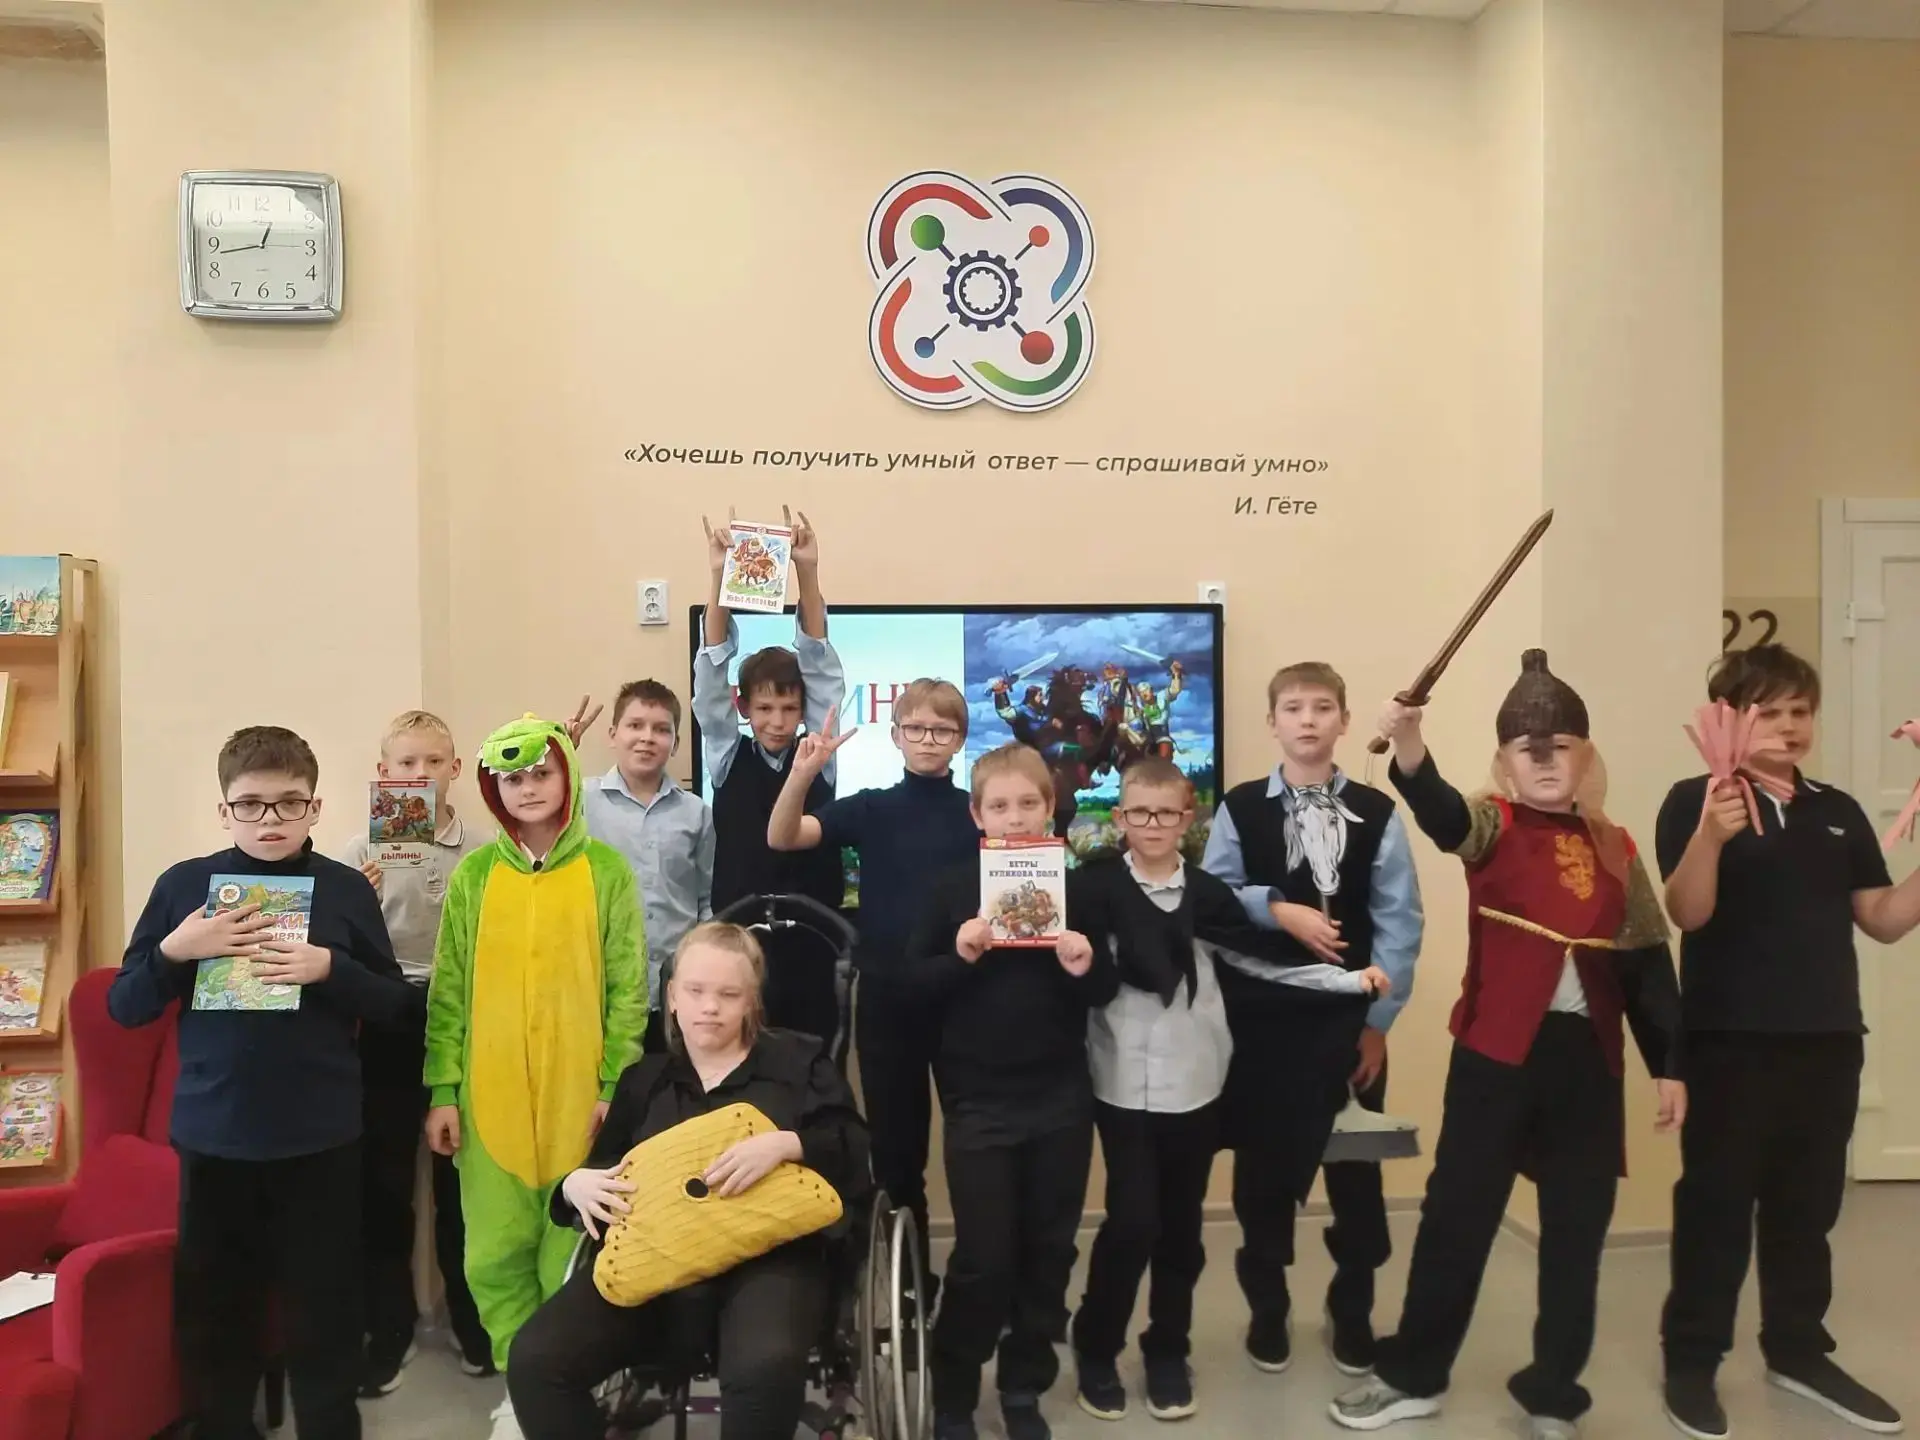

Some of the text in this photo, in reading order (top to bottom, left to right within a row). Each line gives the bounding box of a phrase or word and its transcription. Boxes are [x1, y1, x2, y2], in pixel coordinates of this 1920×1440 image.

[254, 195, 270, 213] 12
[206, 209, 223, 228] 10
[208, 236, 220, 254] 9
[305, 239, 317, 257] 3
[208, 261, 221, 279] 8
[304, 264, 317, 281] 4
[230, 281, 242, 298] 7
[257, 281, 270, 299] 6
[285, 282, 297, 299] 5
[624, 443, 744, 465] «Хочешь
[752, 449, 879, 472] получить
[883, 449, 976, 472] умный
[987, 454, 1060, 471] ответ
[1095, 453, 1246, 477] спрашивай
[1250, 457, 1329, 477] умно»
[1234, 495, 1318, 515] И. Гёте
[381, 852, 422, 860] БЫЛИНЫ
[1009, 860, 1038, 868] ВЕТРЫ
